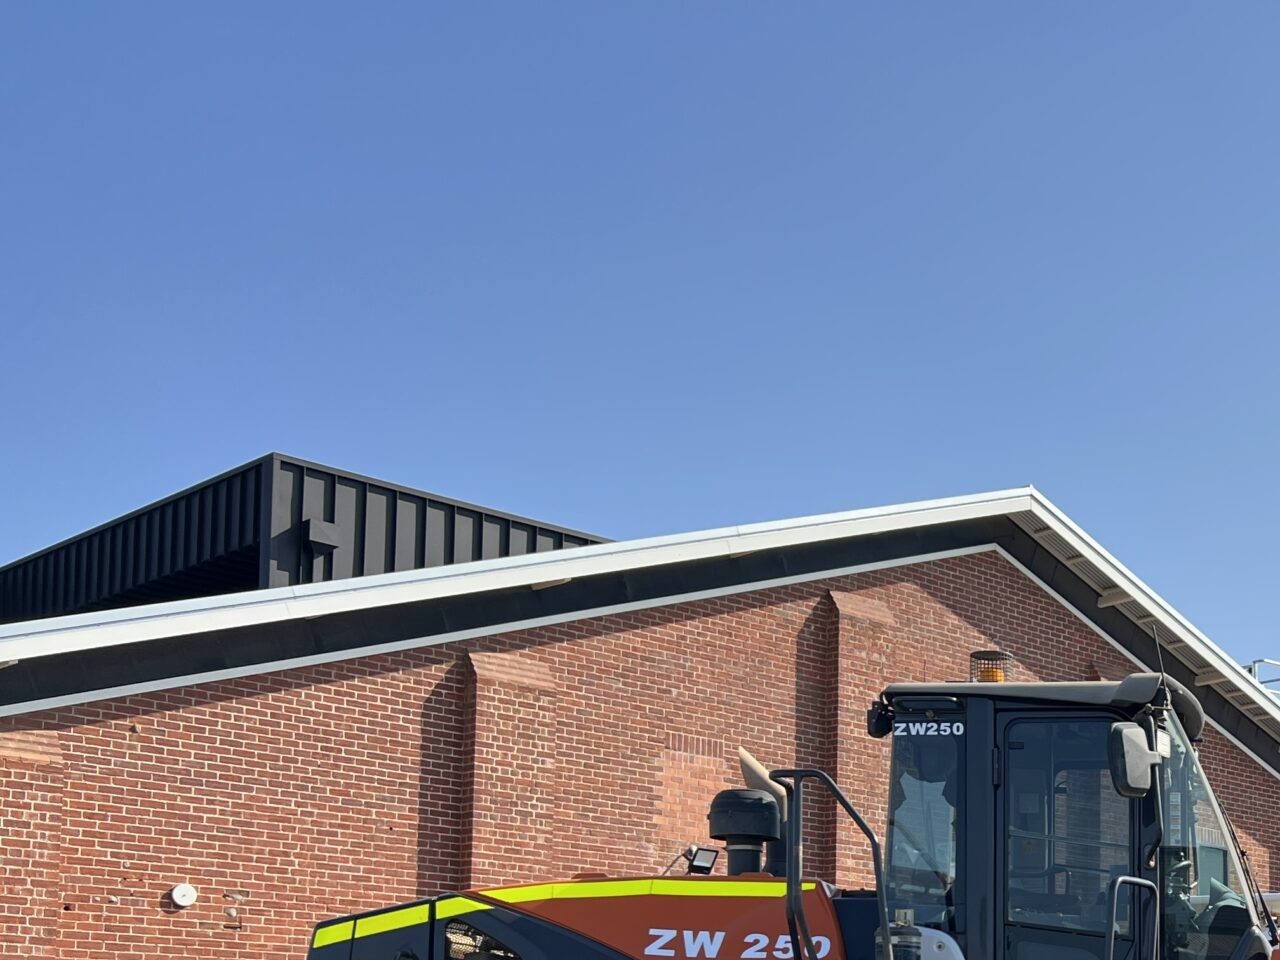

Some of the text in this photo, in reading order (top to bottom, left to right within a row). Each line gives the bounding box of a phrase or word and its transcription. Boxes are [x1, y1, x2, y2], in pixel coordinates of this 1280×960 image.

[894, 722, 964, 736] ZW250
[644, 928, 831, 960] ZW 250
